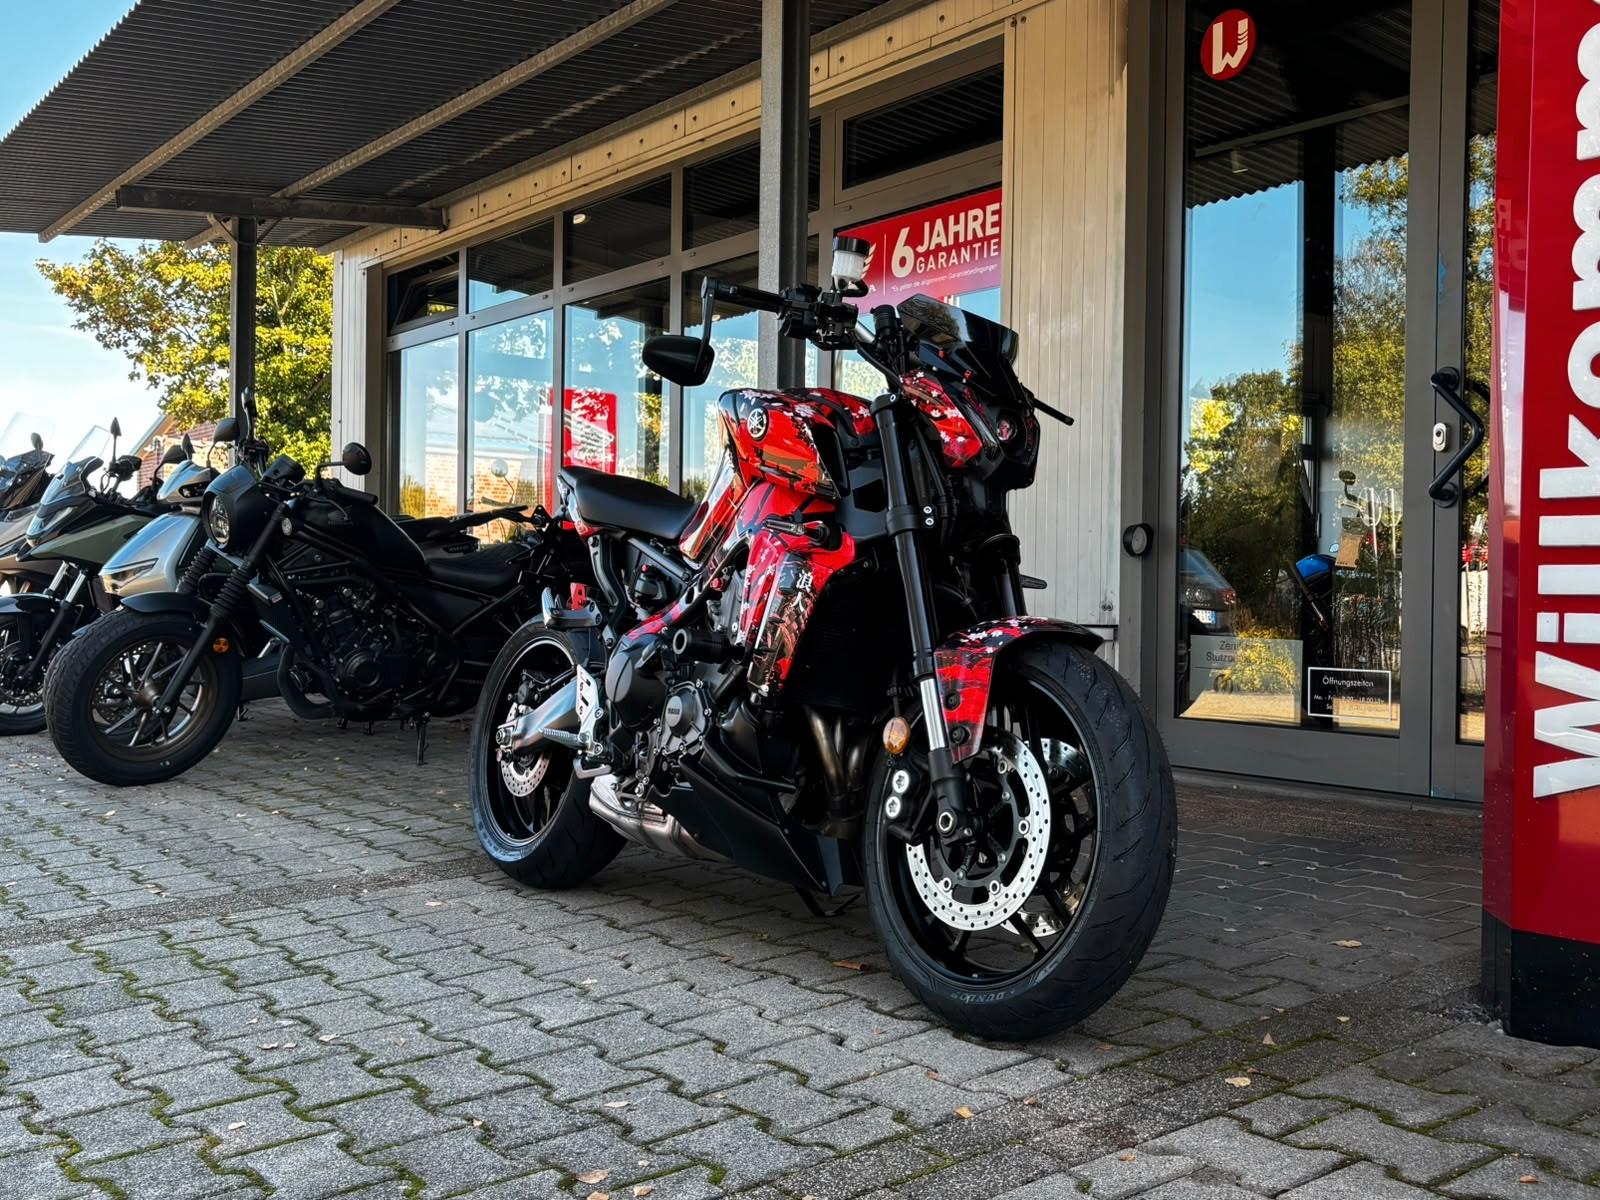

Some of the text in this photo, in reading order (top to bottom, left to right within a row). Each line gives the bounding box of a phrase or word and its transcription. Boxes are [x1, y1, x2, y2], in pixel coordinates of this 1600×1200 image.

[891, 202, 1000, 278] 6 JAHRE
[916, 238, 1000, 274] GARANTIE
[1533, 0, 1600, 798] Willkomm
